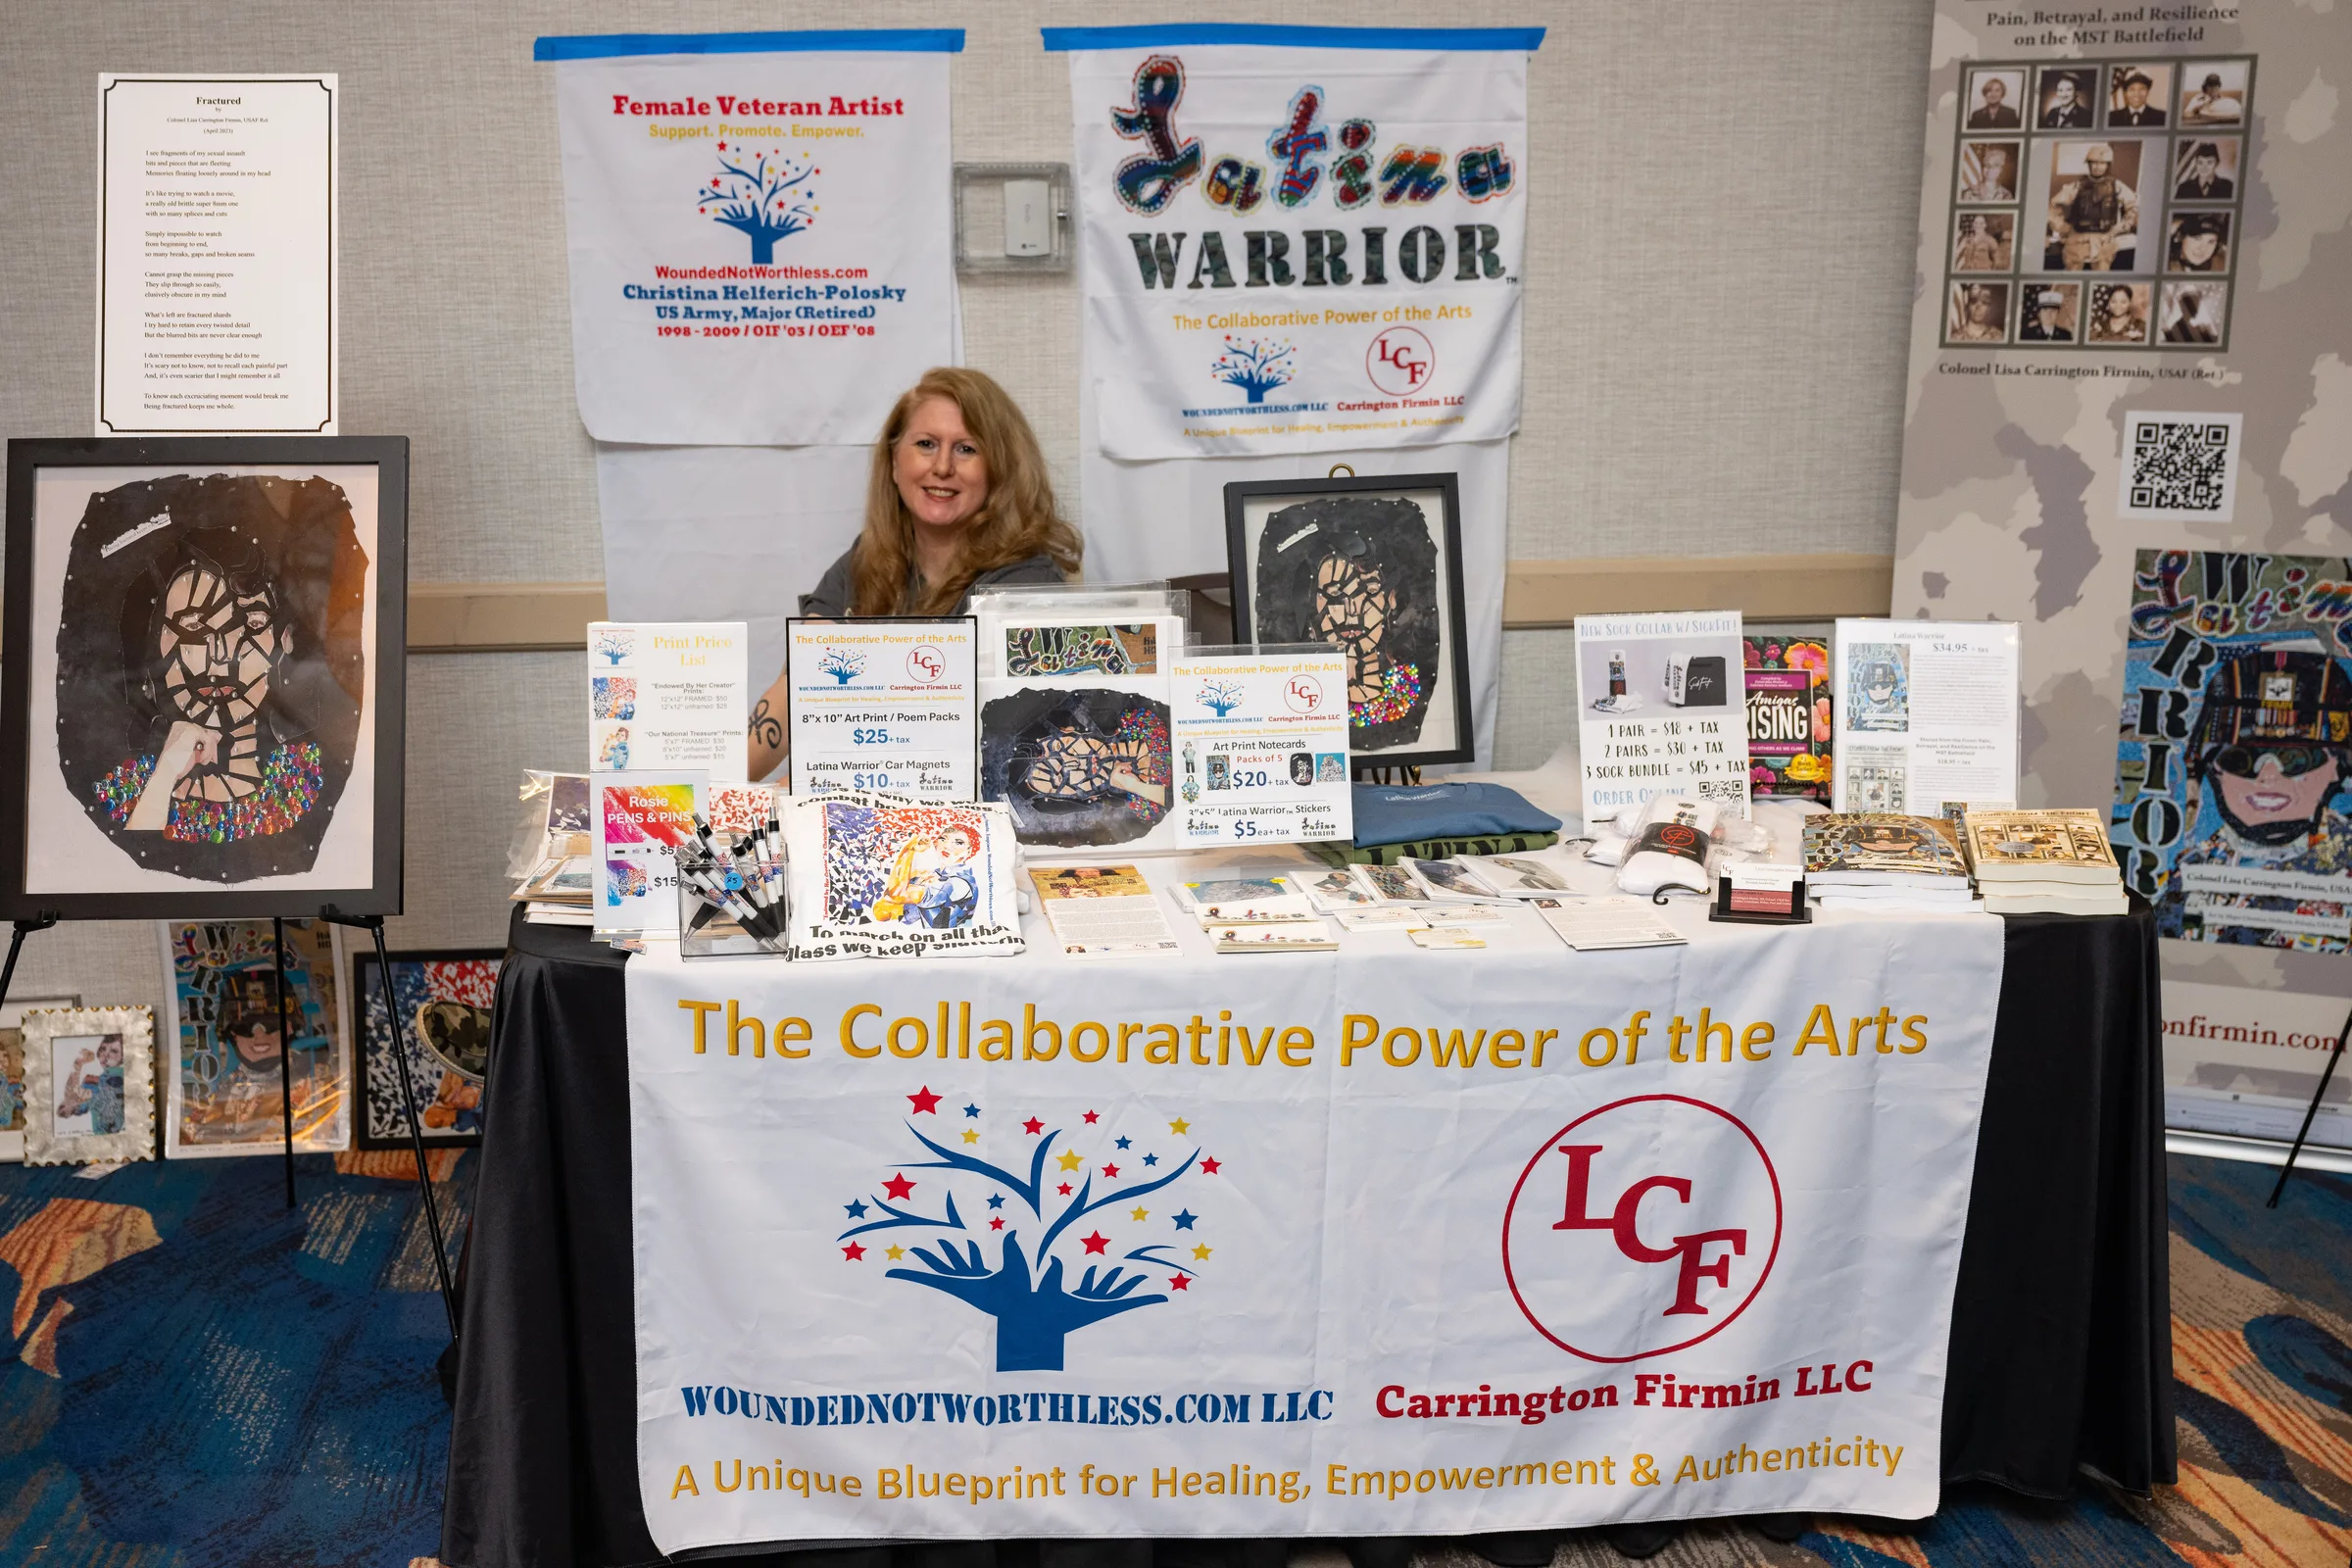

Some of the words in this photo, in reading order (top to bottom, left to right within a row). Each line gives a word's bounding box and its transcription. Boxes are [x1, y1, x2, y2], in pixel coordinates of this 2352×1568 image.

[1986, 11, 2028, 25] Pain,
[2033, 8, 2107, 26] Betrayal,
[2111, 7, 2144, 23] and
[2149, 6, 2240, 23] Resilience
[2013, 35, 2035, 46] on
[2039, 29, 2068, 46] the
[2072, 29, 2109, 44] MST
[2114, 25, 2204, 43] Battlefield
[196, 96, 240, 105] Fractured
[612, 94, 710, 116] Female
[715, 95, 822, 116] Veteran
[827, 95, 904, 116] Artist
[649, 123, 713, 140] Support.
[718, 122, 786, 137] Promote.
[791, 123, 864, 139] Empower.
[1109, 54, 1516, 218] Latina
[655, 266, 867, 279] WoundedNotWorthless.com
[622, 283, 718, 300] Christina
[721, 284, 906, 302] Helferich-Polosky
[655, 305, 679, 318] US
[682, 306, 738, 322] Army,
[741, 306, 792, 321] Major
[795, 305, 875, 318] (Retired)
[1172, 315, 1202, 329] The
[1206, 311, 1319, 329] Collaborative
[1324, 310, 1378, 324] Power
[1382, 307, 1399, 321] of
[1403, 306, 1432, 321] the
[1436, 305, 1472, 319] Arts
[658, 325, 691, 337] 1998
[703, 326, 740, 337] 2009
[753, 324, 780, 337] OIF
[817, 324, 850, 336] OEF
[1938, 363, 1991, 376] Colonel
[1994, 364, 2021, 376] Lisa
[2024, 365, 2099, 379] Carrington
[2103, 366, 2155, 379] Firmin,
[2158, 368, 2189, 379] USAF
[654, 636, 689, 649] Print
[695, 635, 731, 649] Price
[1933, 643, 1967, 653] $34.95
[680, 654, 706, 665] List
[1173, 666, 1191, 675] The
[1193, 664, 1256, 674] Collaborative
[1259, 663, 1290, 672] Power
[1292, 662, 1301, 672] of
[1304, 662, 1320, 672] the
[1746, 691, 1798, 707] Amigas
[844, 713, 860, 722] Art
[862, 712, 887, 722] Print
[897, 712, 926, 721] Poem
[929, 711, 959, 720] Packs
[853, 727, 888, 746] $25
[1608, 723, 1613, 737] 1
[1619, 724, 1644, 737] PAIR
[1663, 721, 1681, 735] $18
[1699, 721, 1718, 733] TAX
[1212, 742, 1229, 751] Art
[1231, 741, 1255, 750] Print
[1258, 739, 1305, 749] Notecards
[1604, 744, 1610, 758] 2
[1616, 744, 1647, 758] PAIRS
[1667, 741, 1686, 756] $30
[1704, 741, 1723, 754] TAX
[807, 761, 838, 770] Latina
[885, 760, 904, 769] Car
[906, 760, 950, 770] Magnets
[1237, 755, 1262, 763] Packs
[1264, 754, 1274, 762] of
[854, 772, 888, 789] $10
[1233, 770, 1266, 789] $20
[628, 796, 669, 808] Rosie
[797, 795, 869, 808] combat
[1295, 804, 1331, 813] Stickers
[608, 812, 644, 824] PENS
[647, 812, 657, 823] &
[660, 811, 692, 822] PINS
[1234, 819, 1256, 839] $5
[809, 925, 833, 938] To
[840, 930, 903, 941] march
[909, 932, 935, 943] on
[941, 929, 964, 941] all
[970, 925, 1010, 939] tha
[786, 945, 837, 960] glass
[843, 943, 871, 954] we
[877, 943, 926, 956] keep
[677, 999, 812, 1058] The
[839, 1001, 1314, 1067] Collaborative
[1340, 1013, 1558, 1068] Power
[1578, 1009, 1650, 1065] of
[1666, 1009, 1776, 1063] the
[1791, 1004, 1928, 1056] Arts
[1375, 1385, 1619, 1425] Carrington
[1633, 1371, 1781, 1409] Firmin
[1793, 1359, 1873, 1396] LLC
[680, 1385, 1250, 1426] WOUNDEDNOTWORTHLESS.COM
[1260, 1390, 1333, 1422] LLC
[669, 1464, 700, 1499] A
[713, 1458, 861, 1497] Unique
[877, 1463, 1065, 1505] Blueprint
[1078, 1463, 1138, 1497] for
[1152, 1463, 1310, 1503] Healing,
[1326, 1455, 1615, 1500] Empowerment
[1629, 1452, 1660, 1486] &
[1672, 1435, 1904, 1484] Authenticity
